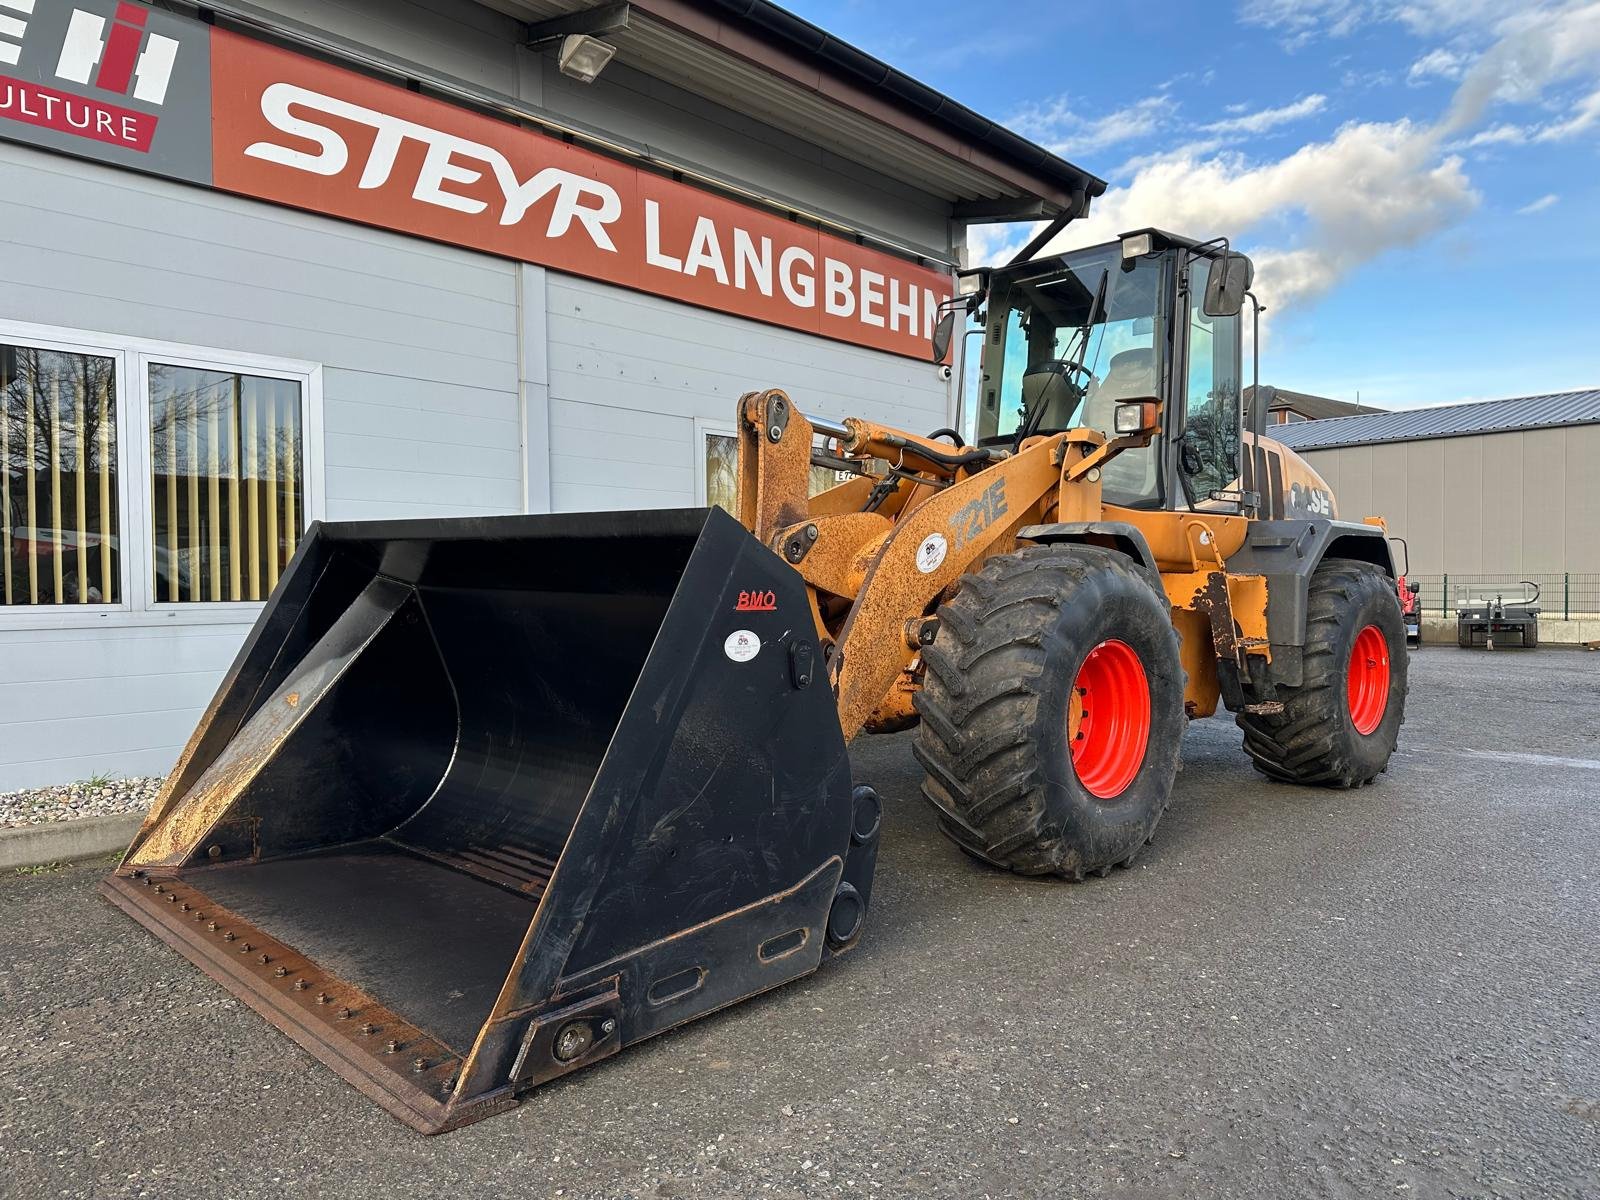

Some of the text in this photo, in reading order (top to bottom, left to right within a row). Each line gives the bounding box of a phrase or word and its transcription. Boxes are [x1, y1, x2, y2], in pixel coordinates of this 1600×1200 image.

[243, 82, 951, 341] STEYR LANGBEHN
[949, 476, 1009, 552] 721E
[737, 590, 776, 608] BMO
